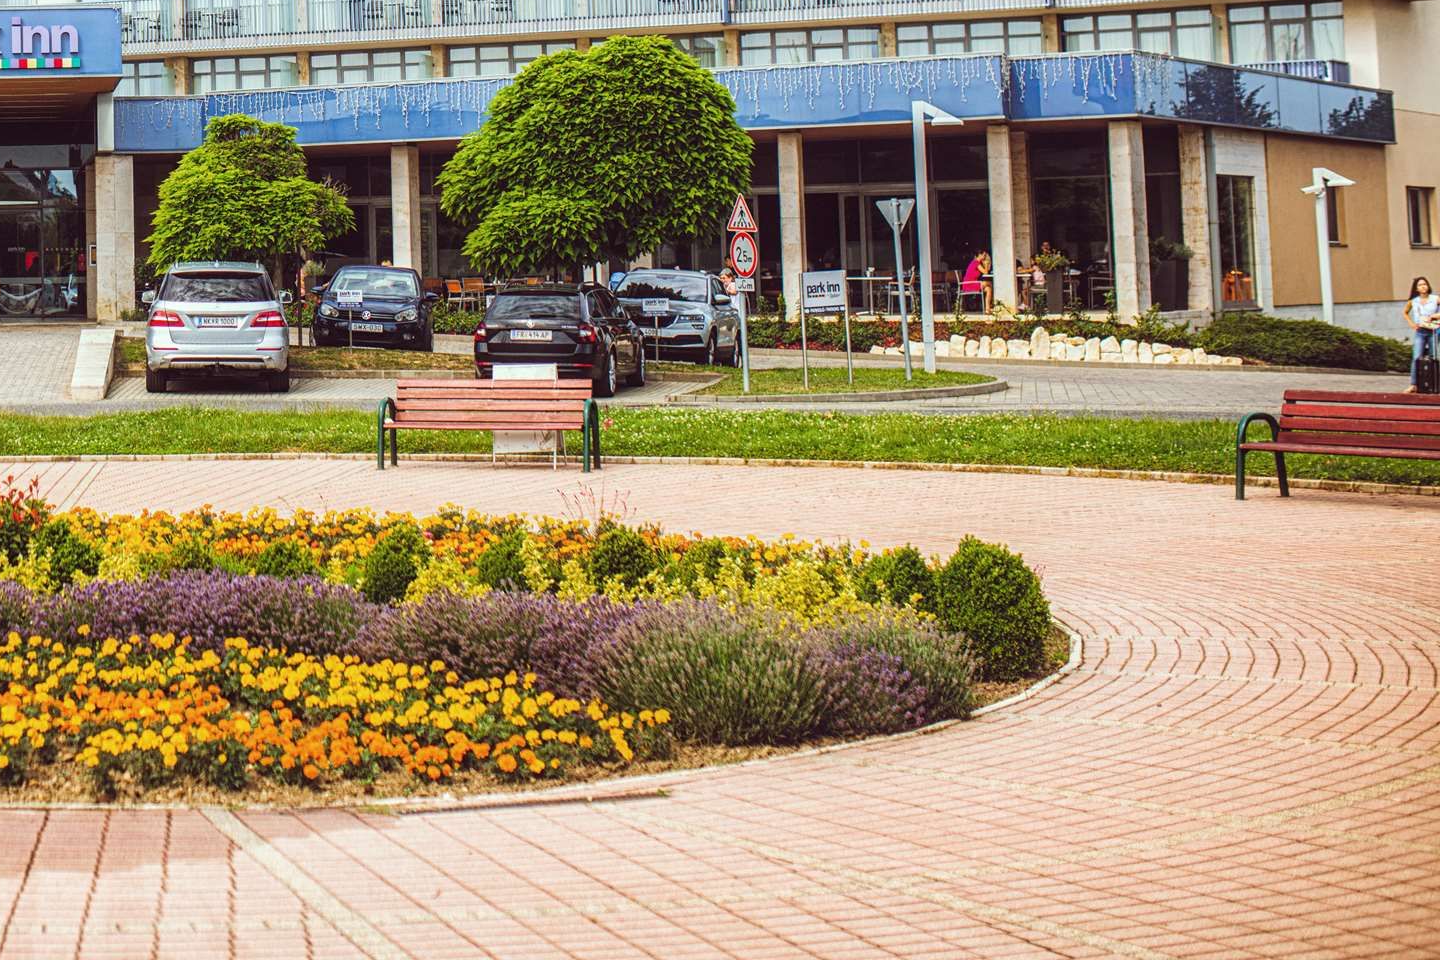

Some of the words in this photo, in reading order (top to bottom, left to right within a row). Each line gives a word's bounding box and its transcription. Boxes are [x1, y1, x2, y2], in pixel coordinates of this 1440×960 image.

[11, 16, 80, 54] inn
[807, 282, 826, 298] park
[827, 281, 840, 293] inn
